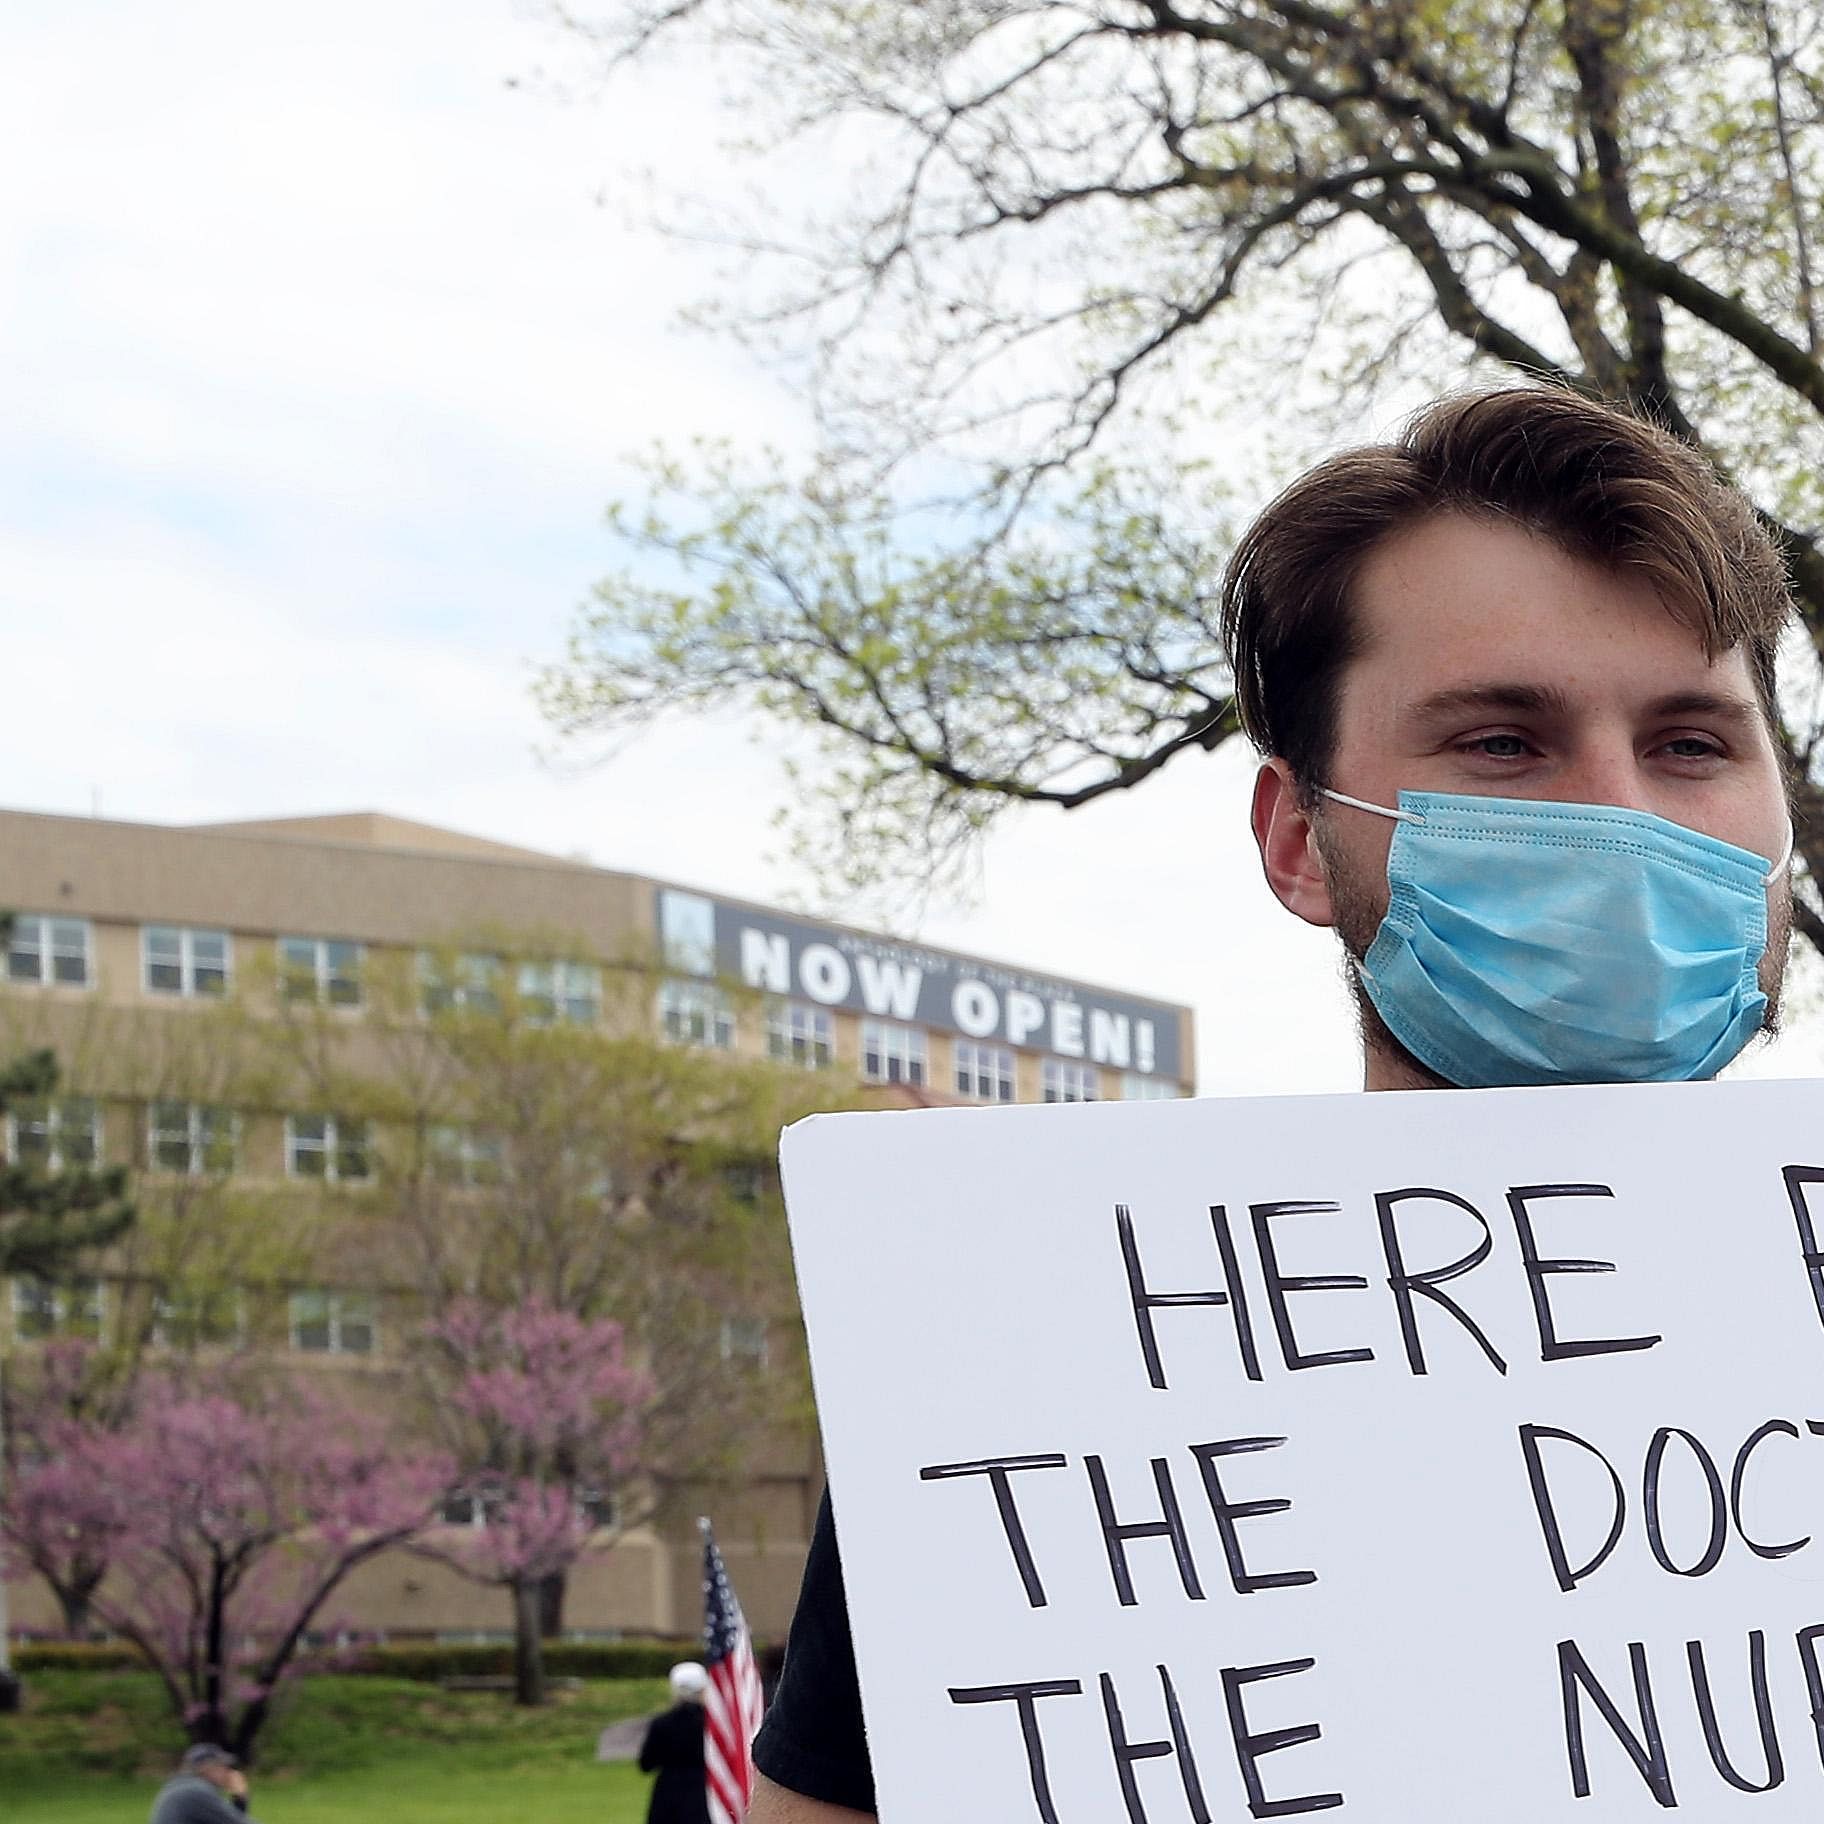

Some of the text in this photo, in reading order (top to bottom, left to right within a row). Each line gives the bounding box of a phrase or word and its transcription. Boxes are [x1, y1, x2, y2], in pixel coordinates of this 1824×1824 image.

[741, 927, 922, 1021] NOW
[951, 978, 1156, 1075] OPEN!
[1116, 1184, 1662, 1389] HERE
[920, 1437, 1318, 1608] THE
